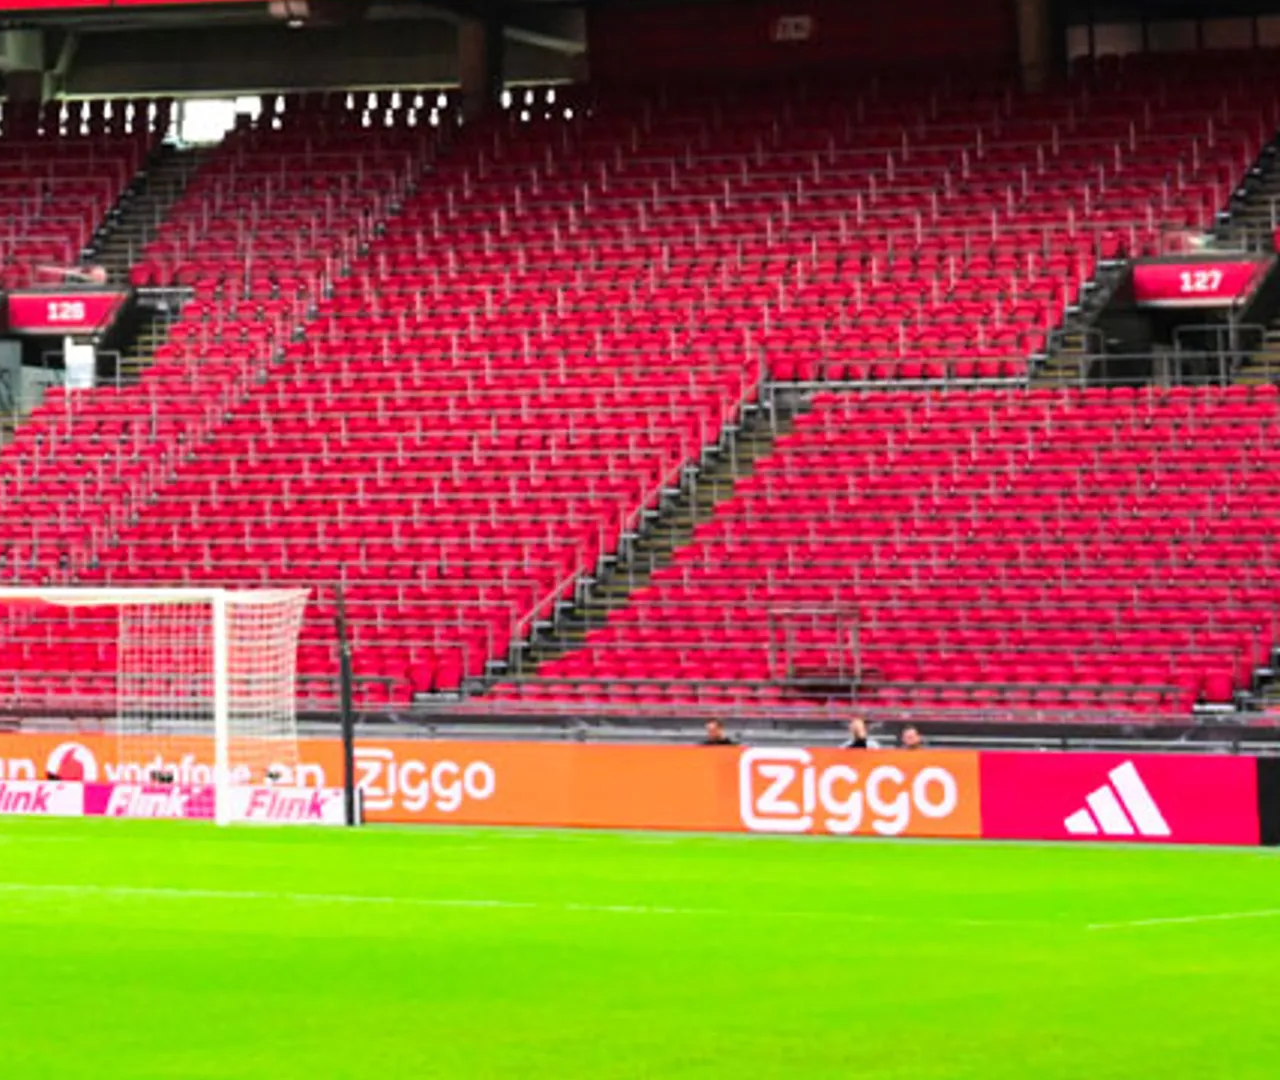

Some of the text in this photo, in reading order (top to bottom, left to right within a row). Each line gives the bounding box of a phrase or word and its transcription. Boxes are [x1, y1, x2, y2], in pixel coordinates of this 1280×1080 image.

[1179, 269, 1223, 292] 127
[103, 753, 252, 786] vodafoe
[353, 747, 496, 812] Ziggo
[245, 788, 326, 819] Flink
[739, 745, 958, 836] Ziggo
